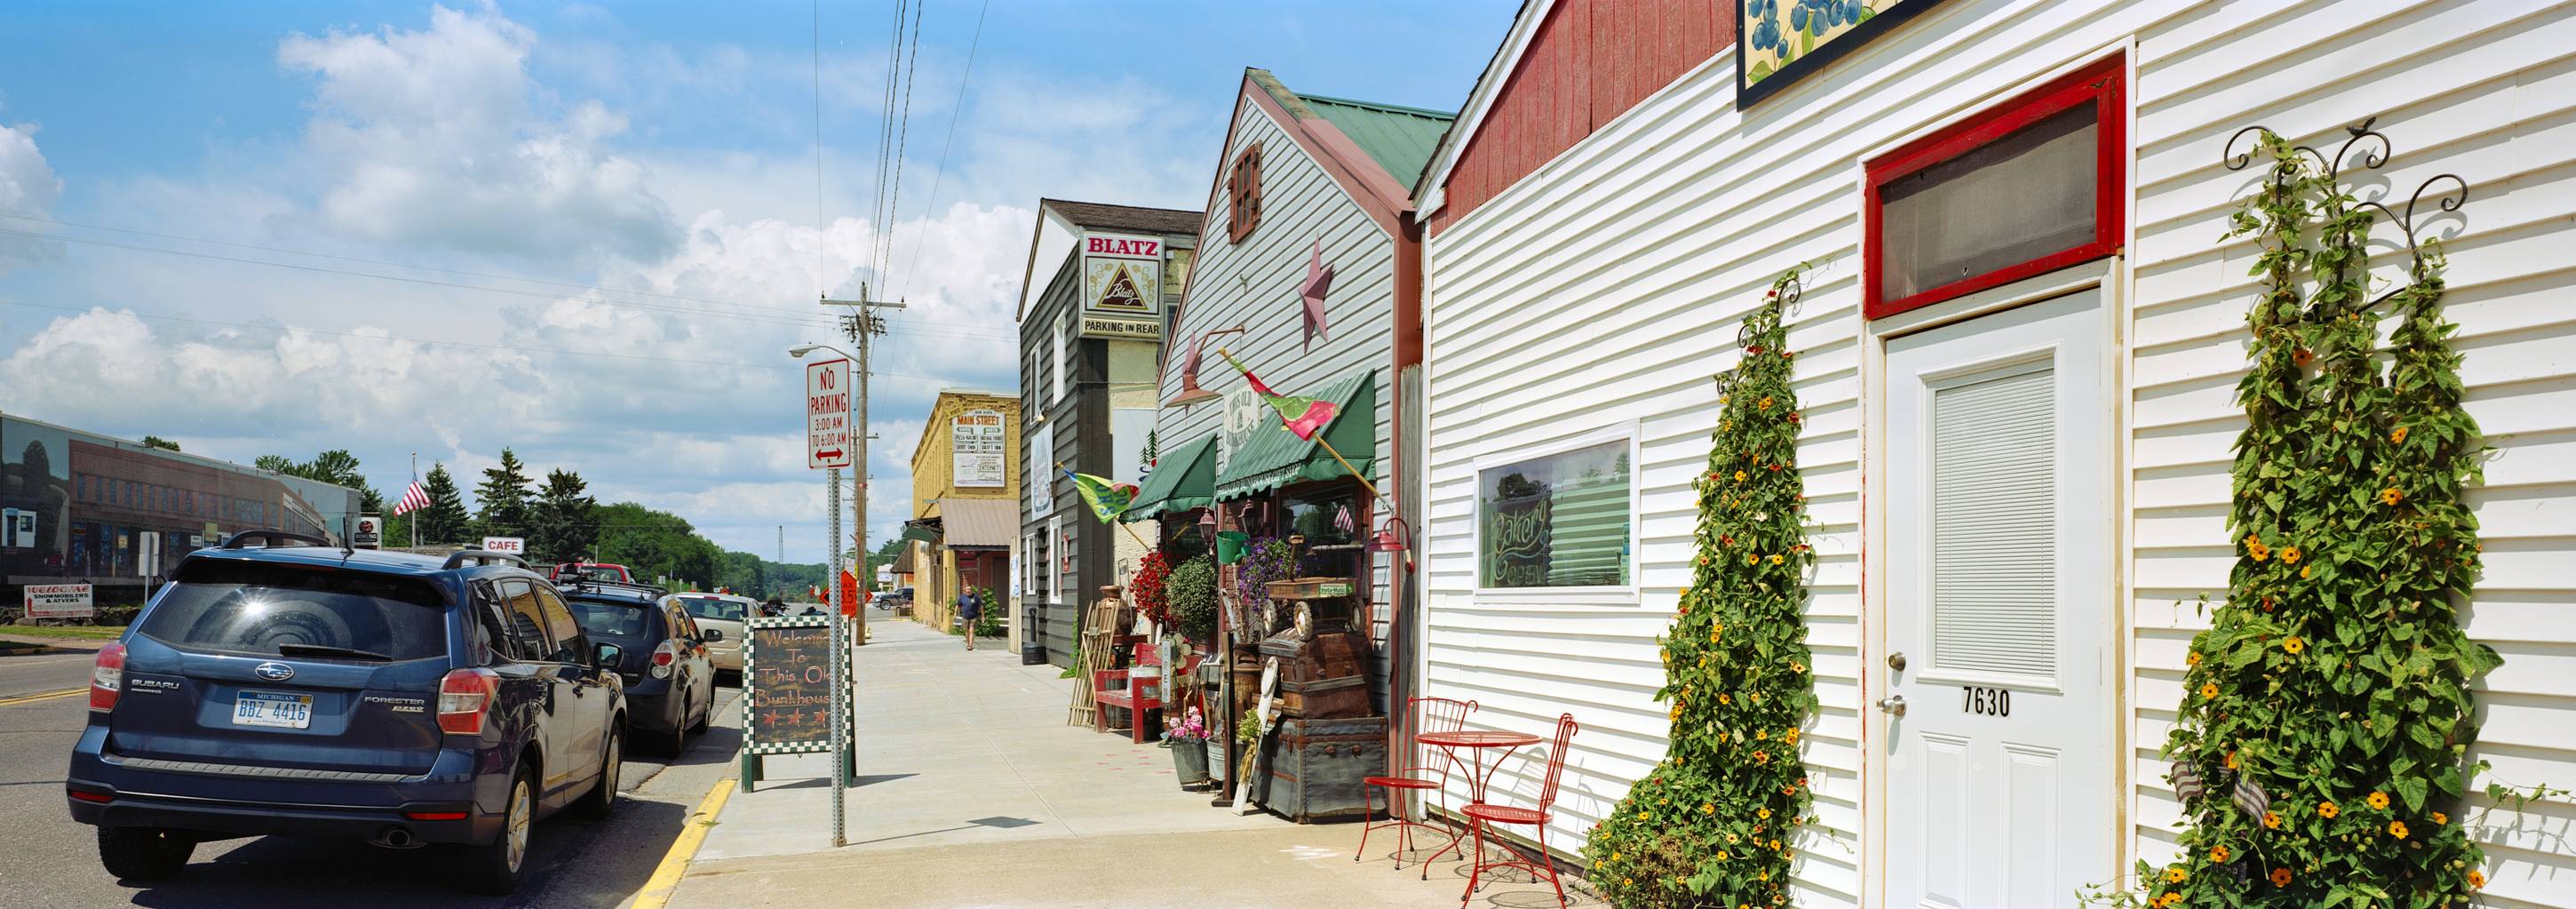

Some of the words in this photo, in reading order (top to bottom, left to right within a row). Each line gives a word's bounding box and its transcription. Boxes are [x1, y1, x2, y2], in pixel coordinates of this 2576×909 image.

[1087, 237, 1158, 256] BLATZ
[1104, 278, 1141, 305] Blatz
[1085, 320, 1124, 332] PARKING
[1136, 323, 1160, 335] REAR
[820, 370, 835, 390] NO
[811, 392, 847, 416] PARKING
[815, 418, 831, 431] 3:00
[832, 416, 843, 429] AM
[958, 415, 974, 425] MAIN
[975, 415, 999, 426] STREET
[812, 435, 820, 447] TO
[821, 433, 835, 446] 6:00
[837, 432, 847, 444] AM
[489, 540, 518, 550] CAFE
[767, 630, 831, 648] Welcome
[786, 649, 807, 666] To
[131, 678, 180, 690] SUBARU
[759, 667, 797, 686] This
[755, 689, 831, 707] Bunkhous
[1963, 686, 2010, 717] 7630
[238, 700, 264, 718] BBZ
[273, 702, 306, 721] 4416
